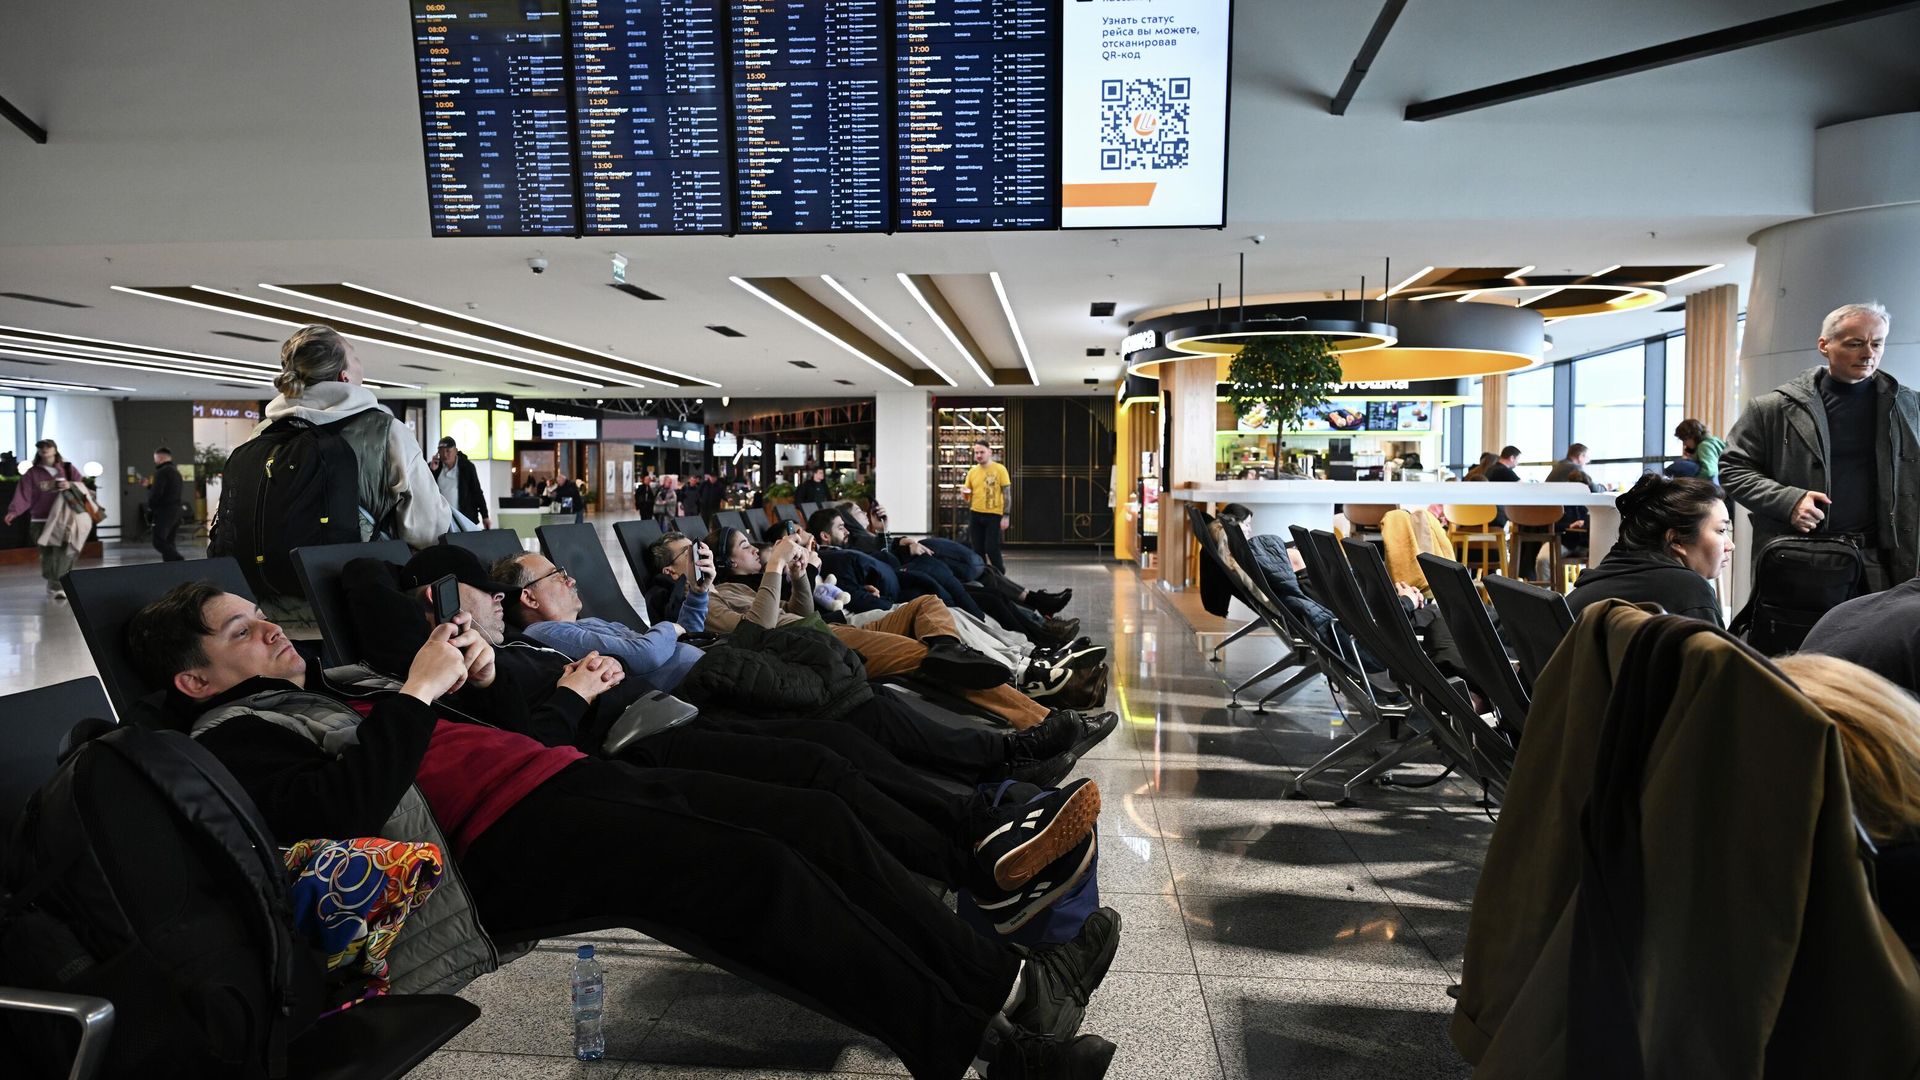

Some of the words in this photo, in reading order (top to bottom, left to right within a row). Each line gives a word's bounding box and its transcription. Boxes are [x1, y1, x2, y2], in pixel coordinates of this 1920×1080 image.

[1102, 17, 1138, 25] Узнать
[1141, 15, 1175, 25] статус
[1102, 28, 1133, 37] рейса
[1138, 28, 1152, 36] вы
[1155, 26, 1200, 36] можете,
[1102, 38, 1177, 48] отсканировав
[1102, 51, 1141, 60] QR-код
